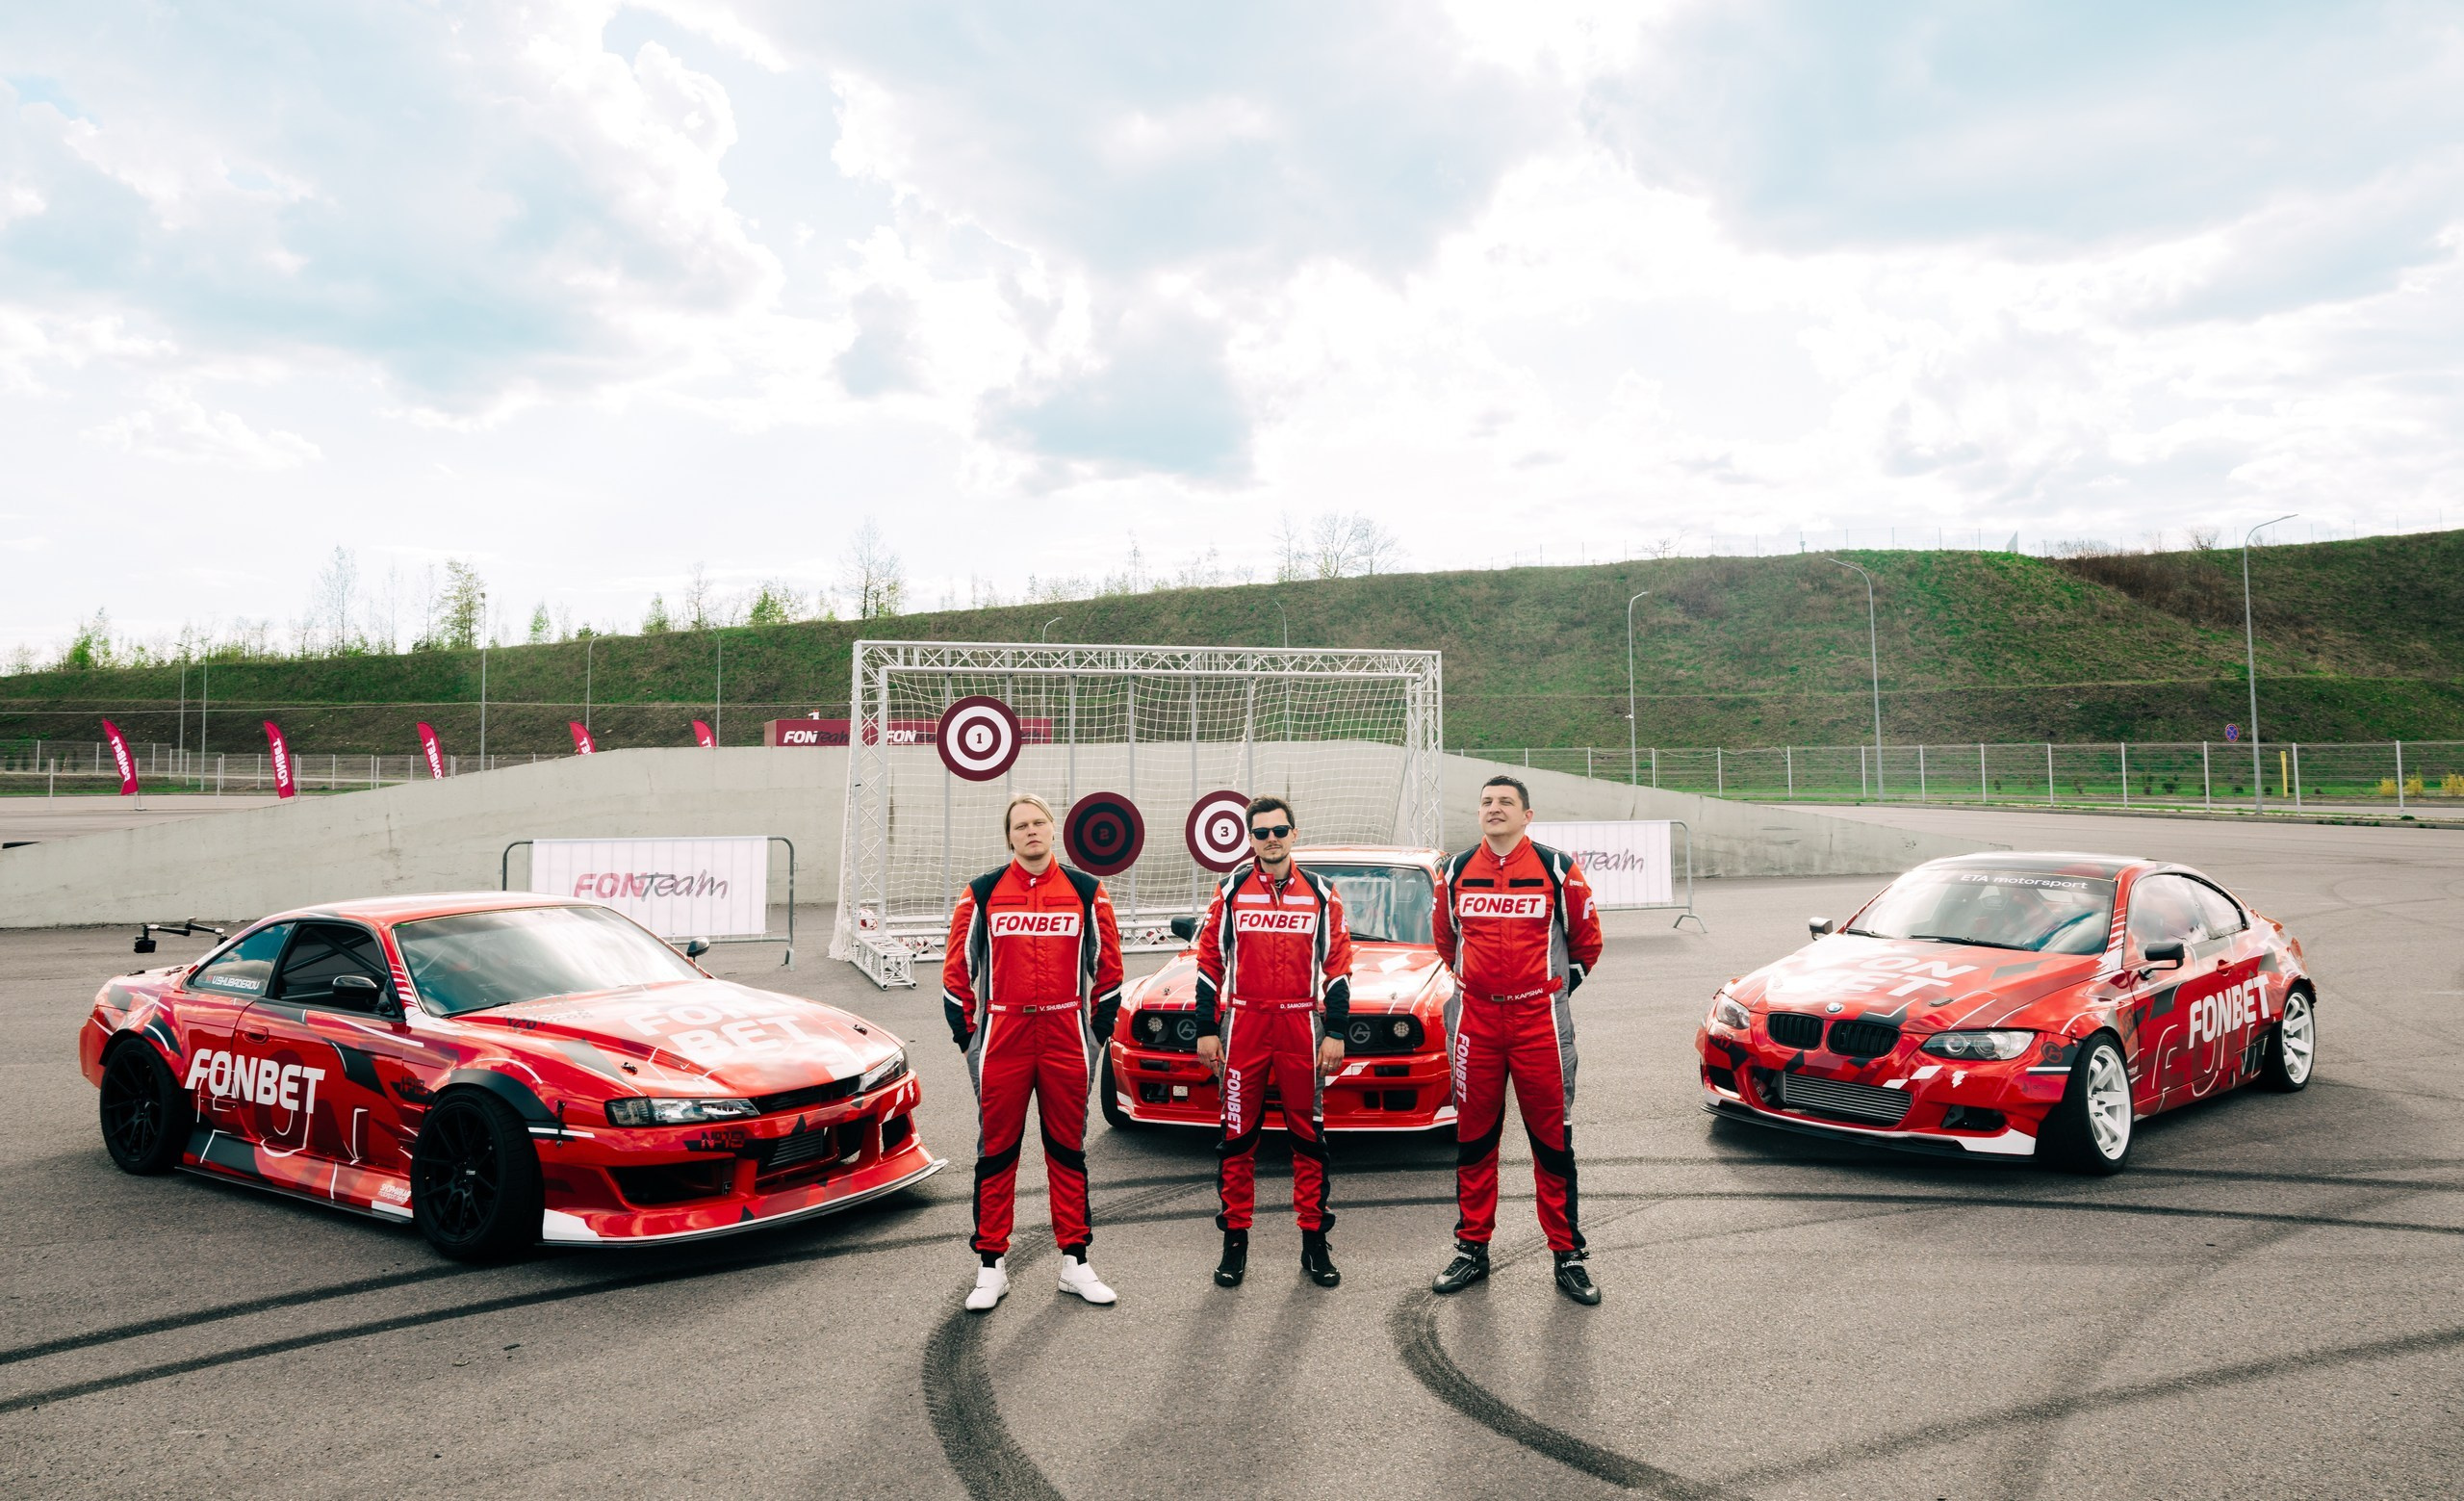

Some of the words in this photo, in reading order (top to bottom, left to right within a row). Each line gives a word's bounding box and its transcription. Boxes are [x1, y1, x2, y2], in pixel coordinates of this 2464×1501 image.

[975, 732, 983, 744] 1
[1099, 828, 1109, 841] 2
[1220, 826, 1229, 837] 3
[1572, 848, 1644, 874] NTeam
[574, 868, 729, 902] FONTeam
[1960, 874, 1989, 883] ETA
[1993, 876, 2089, 890] motorsport
[1462, 896, 1541, 914] FONBET
[995, 916, 1075, 932] FONBET
[1239, 914, 1311, 929] FONBET
[2188, 974, 2271, 1049] FONBET
[668, 1015, 811, 1062] BET
[1455, 1032, 1471, 1103] FONBET
[185, 1048, 326, 1114] FONBET
[1226, 1067, 1242, 1134] FONBET
